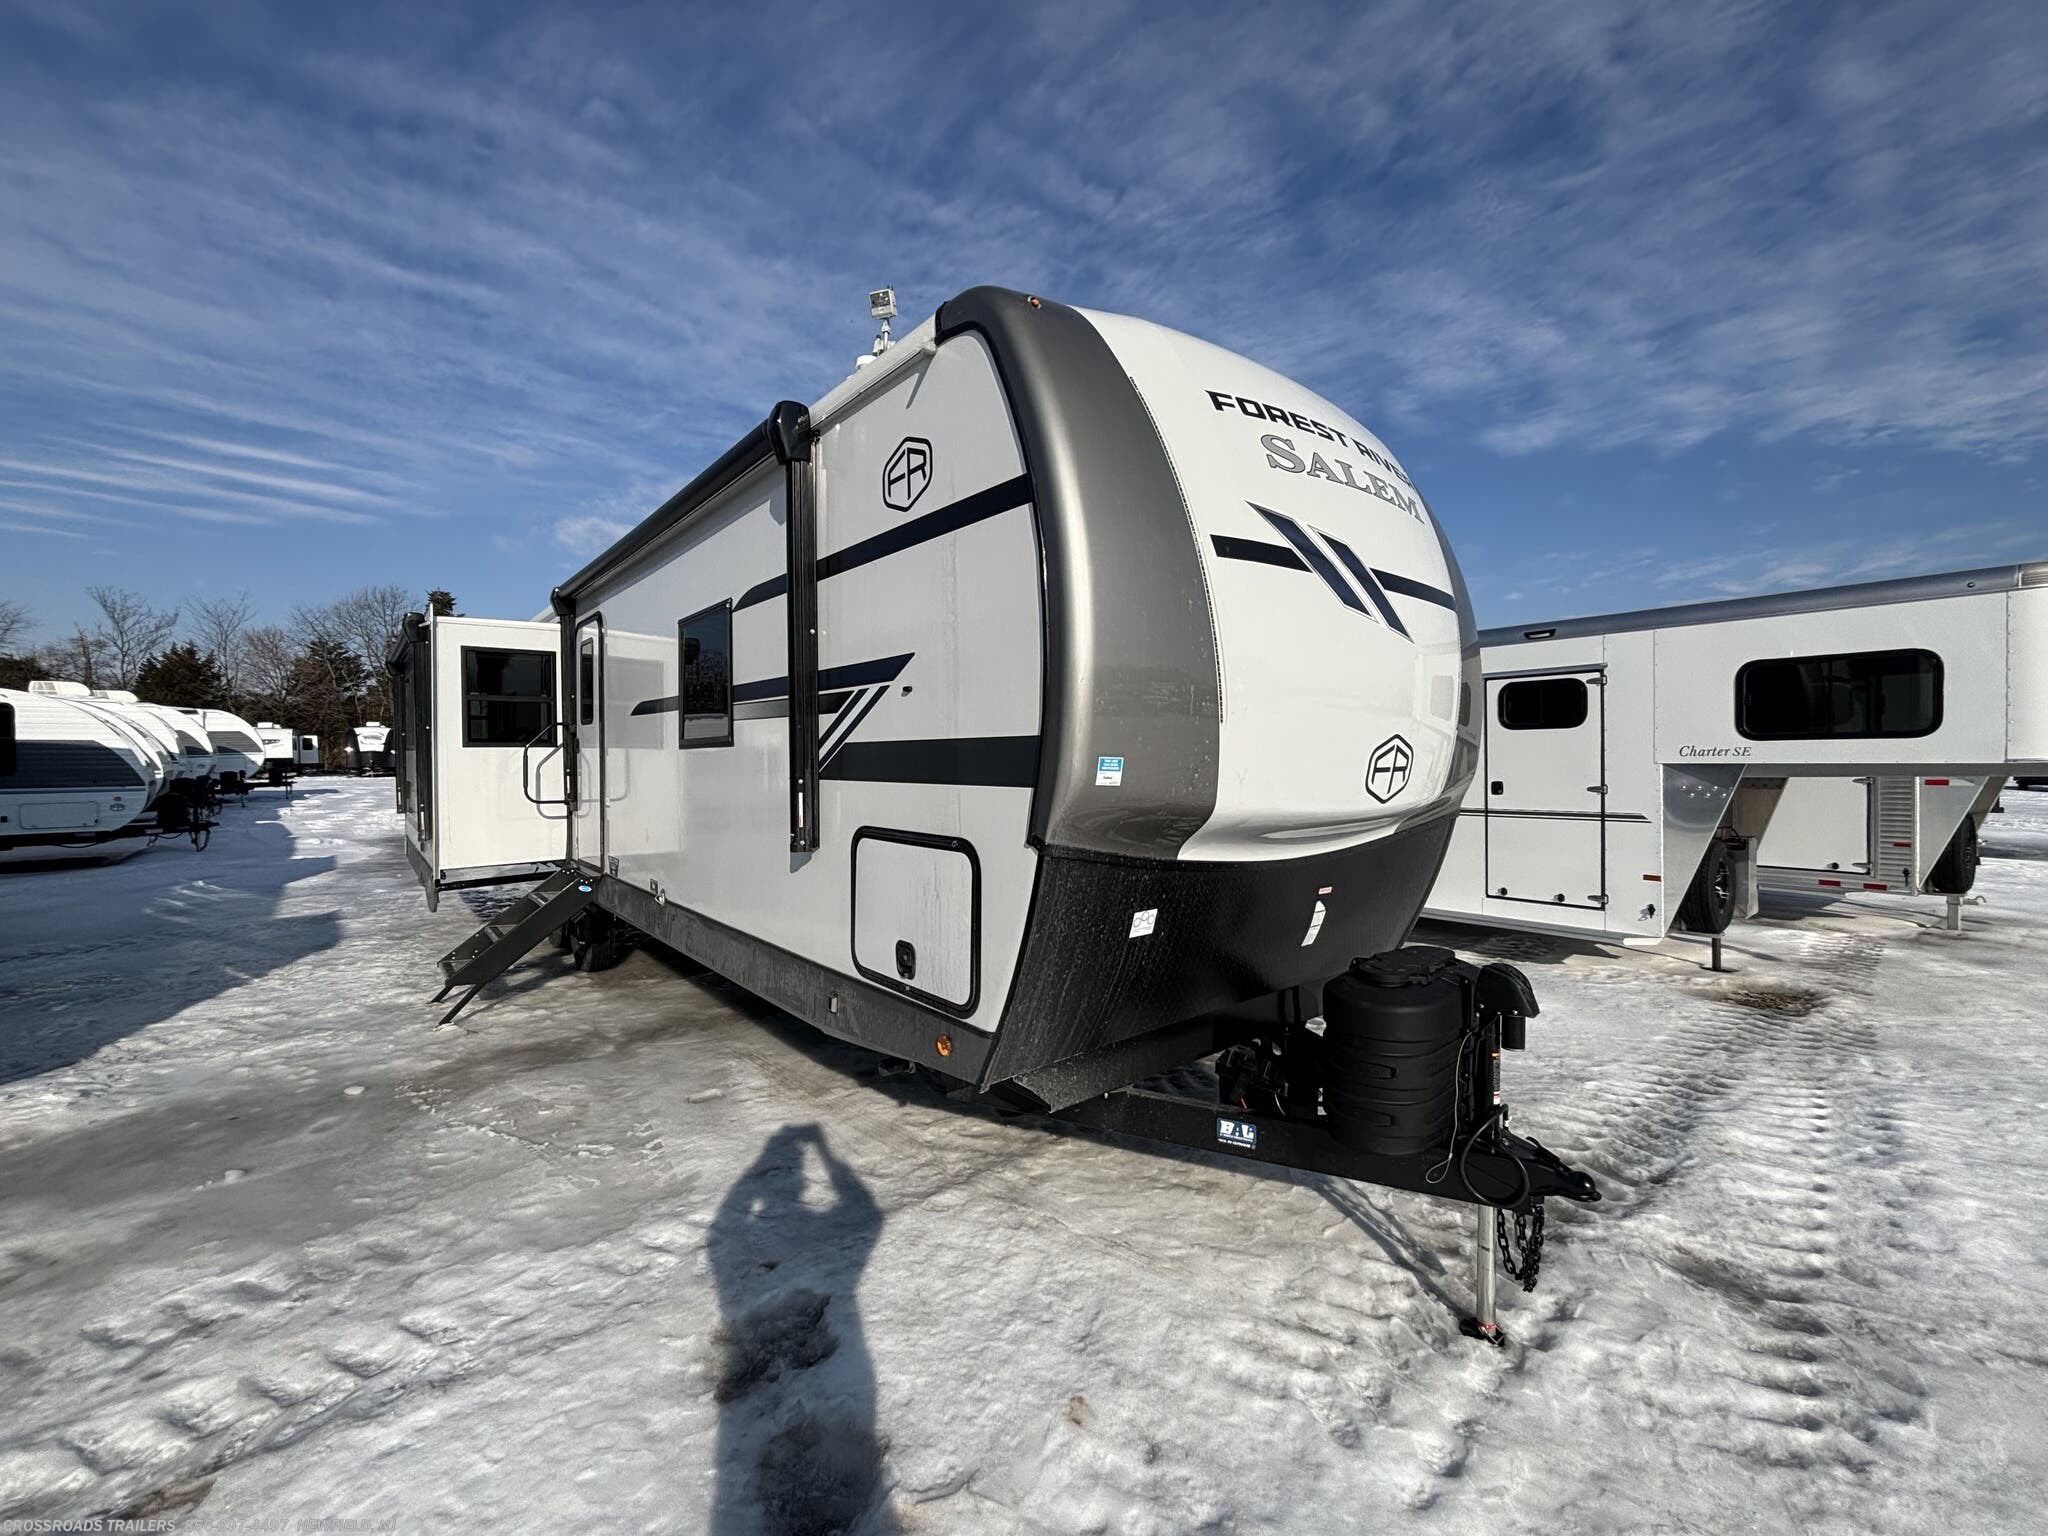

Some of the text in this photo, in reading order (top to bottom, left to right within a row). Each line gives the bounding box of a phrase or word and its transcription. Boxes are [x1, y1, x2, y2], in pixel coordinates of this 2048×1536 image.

[1204, 389, 1347, 447] FOREST
[1260, 434, 1425, 525] SALEM
[1679, 745, 1752, 757] Charter SE
